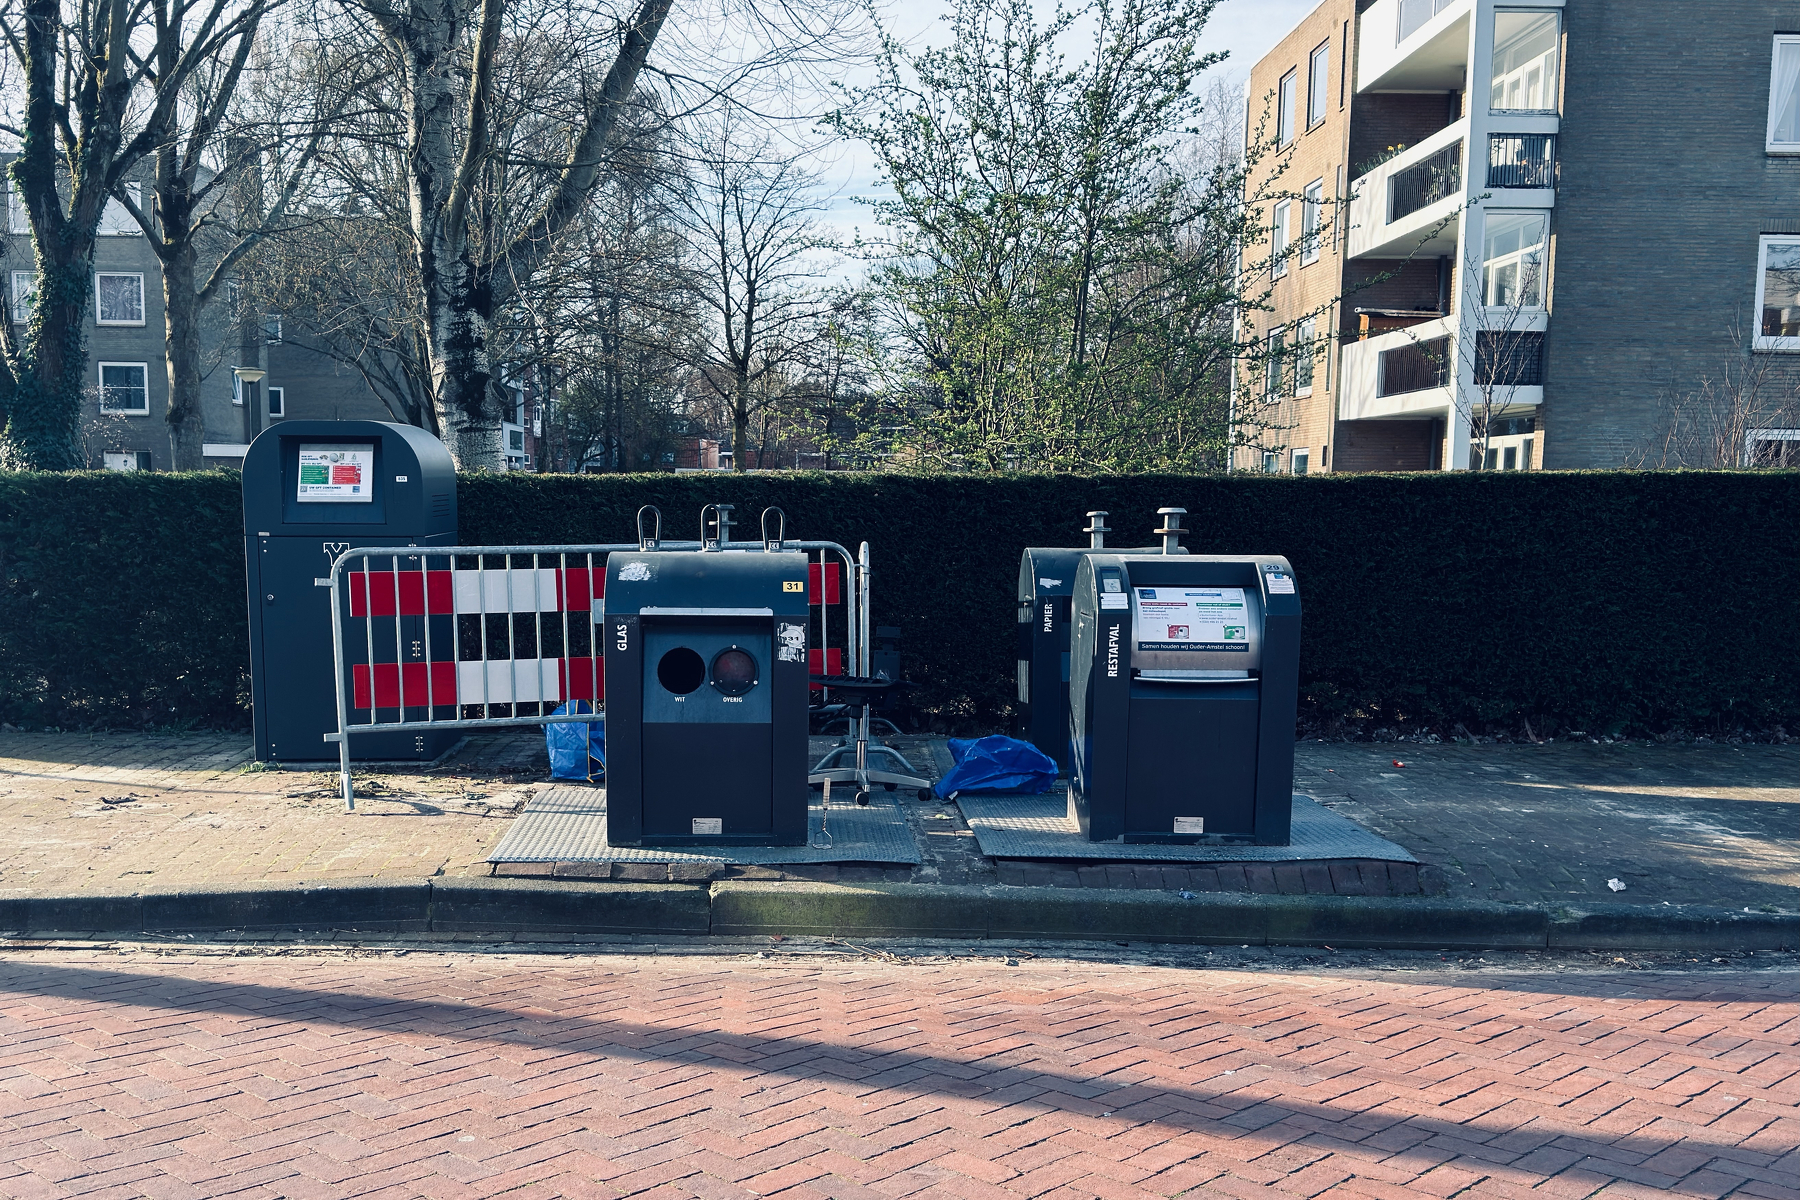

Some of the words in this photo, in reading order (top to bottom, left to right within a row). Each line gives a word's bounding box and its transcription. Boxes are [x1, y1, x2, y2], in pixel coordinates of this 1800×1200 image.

[1044, 603, 1053, 632] PAPIER
[617, 624, 627, 651] GLAS
[1107, 624, 1119, 677] RESTAFVAL
